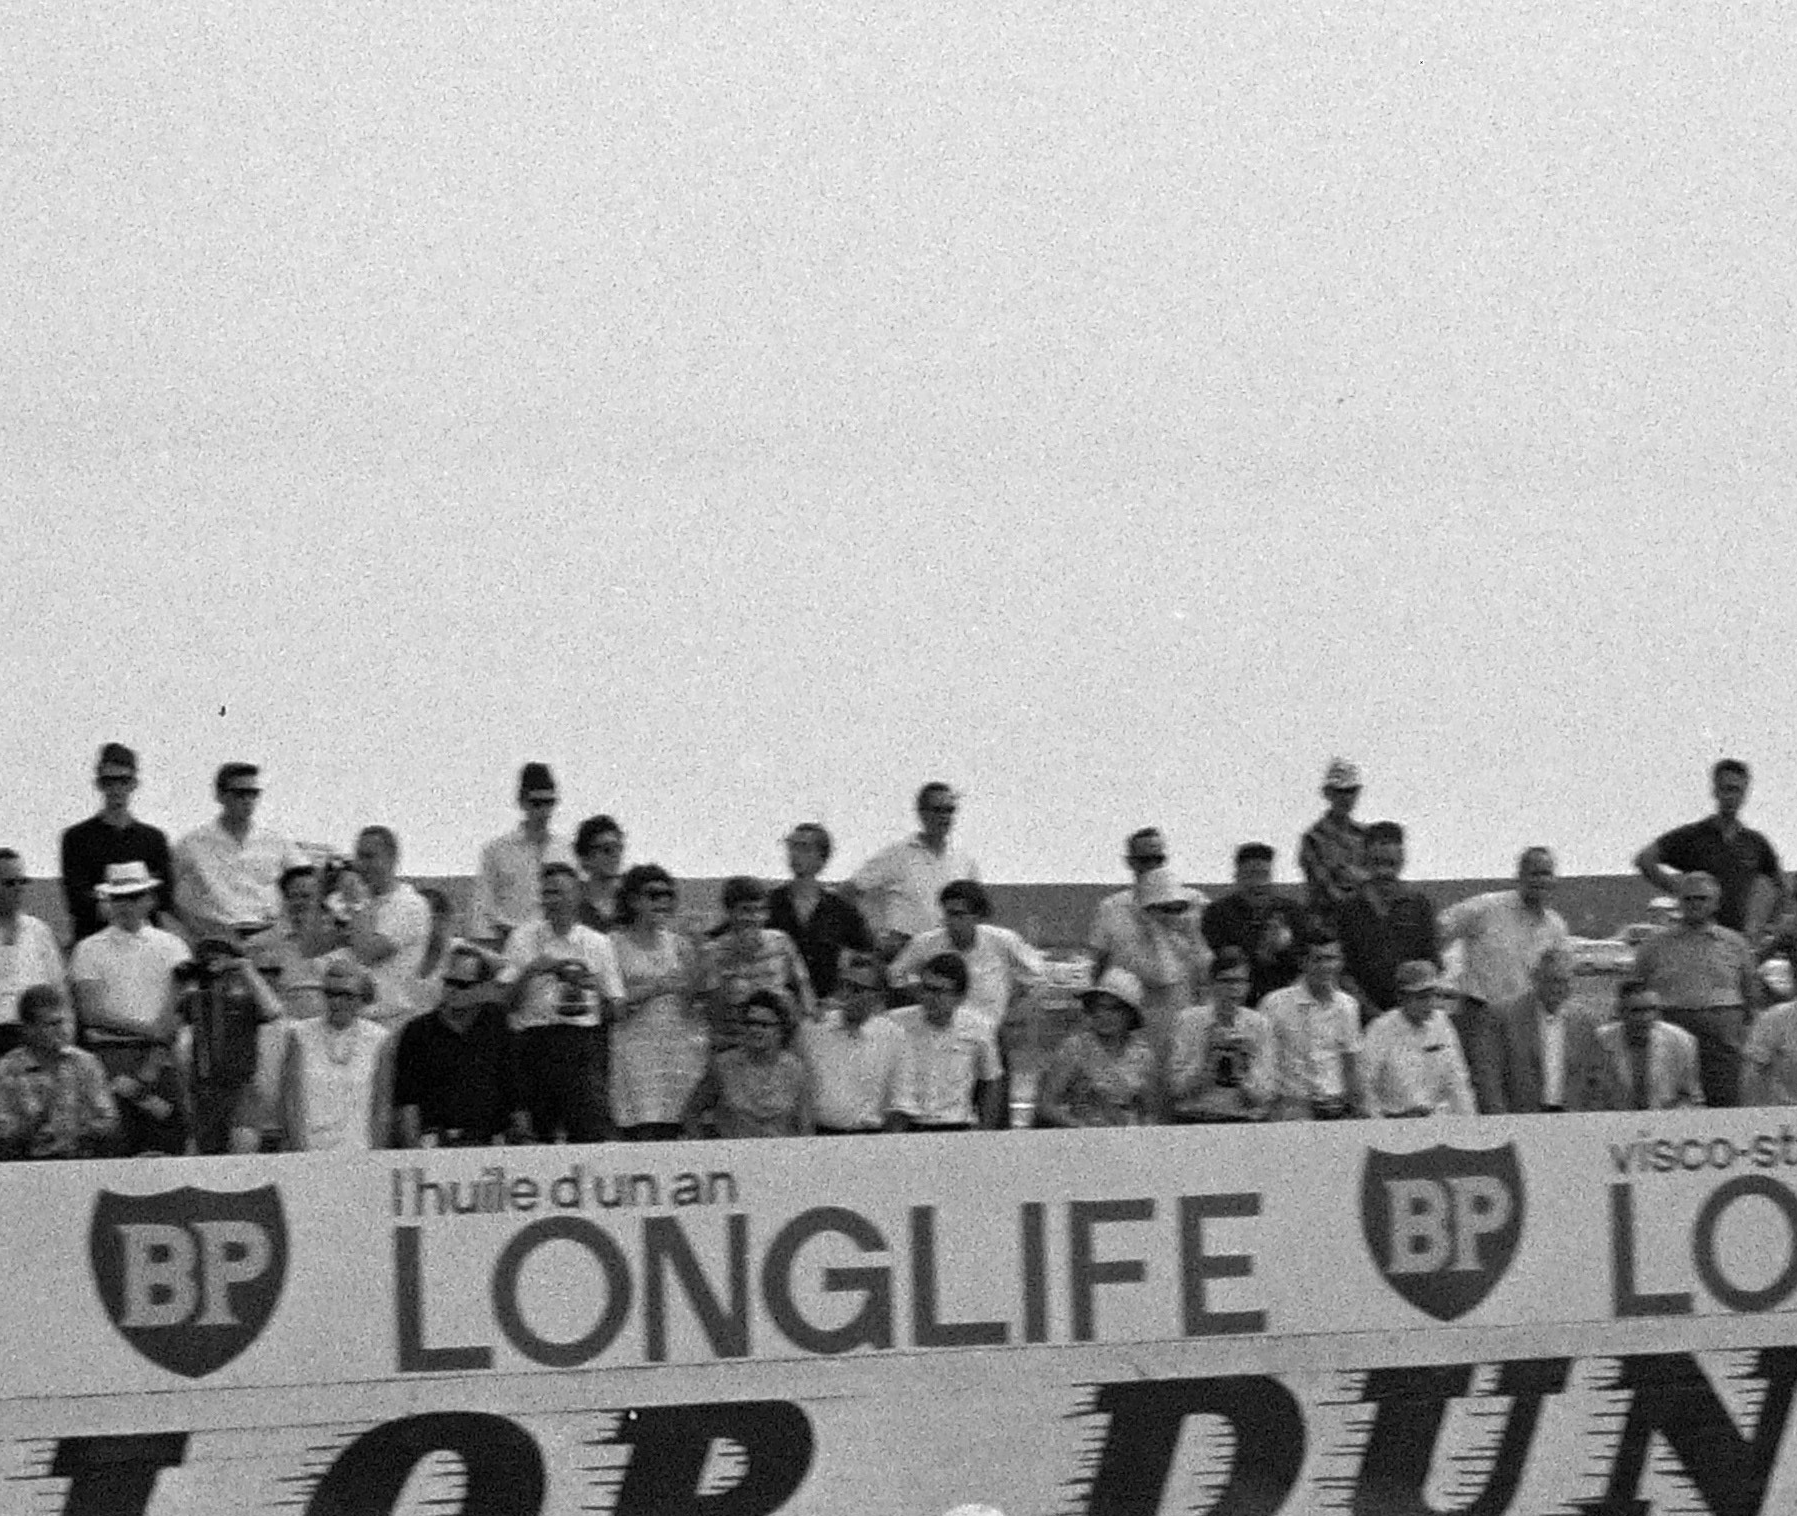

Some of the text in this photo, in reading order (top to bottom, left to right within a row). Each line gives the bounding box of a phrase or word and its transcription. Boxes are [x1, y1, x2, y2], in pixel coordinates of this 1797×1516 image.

[669, 1170, 741, 1208] an
[1383, 1175, 1515, 1275] BP
[117, 1220, 273, 1327] BP
[392, 1193, 1268, 1374] LONGLIFE
